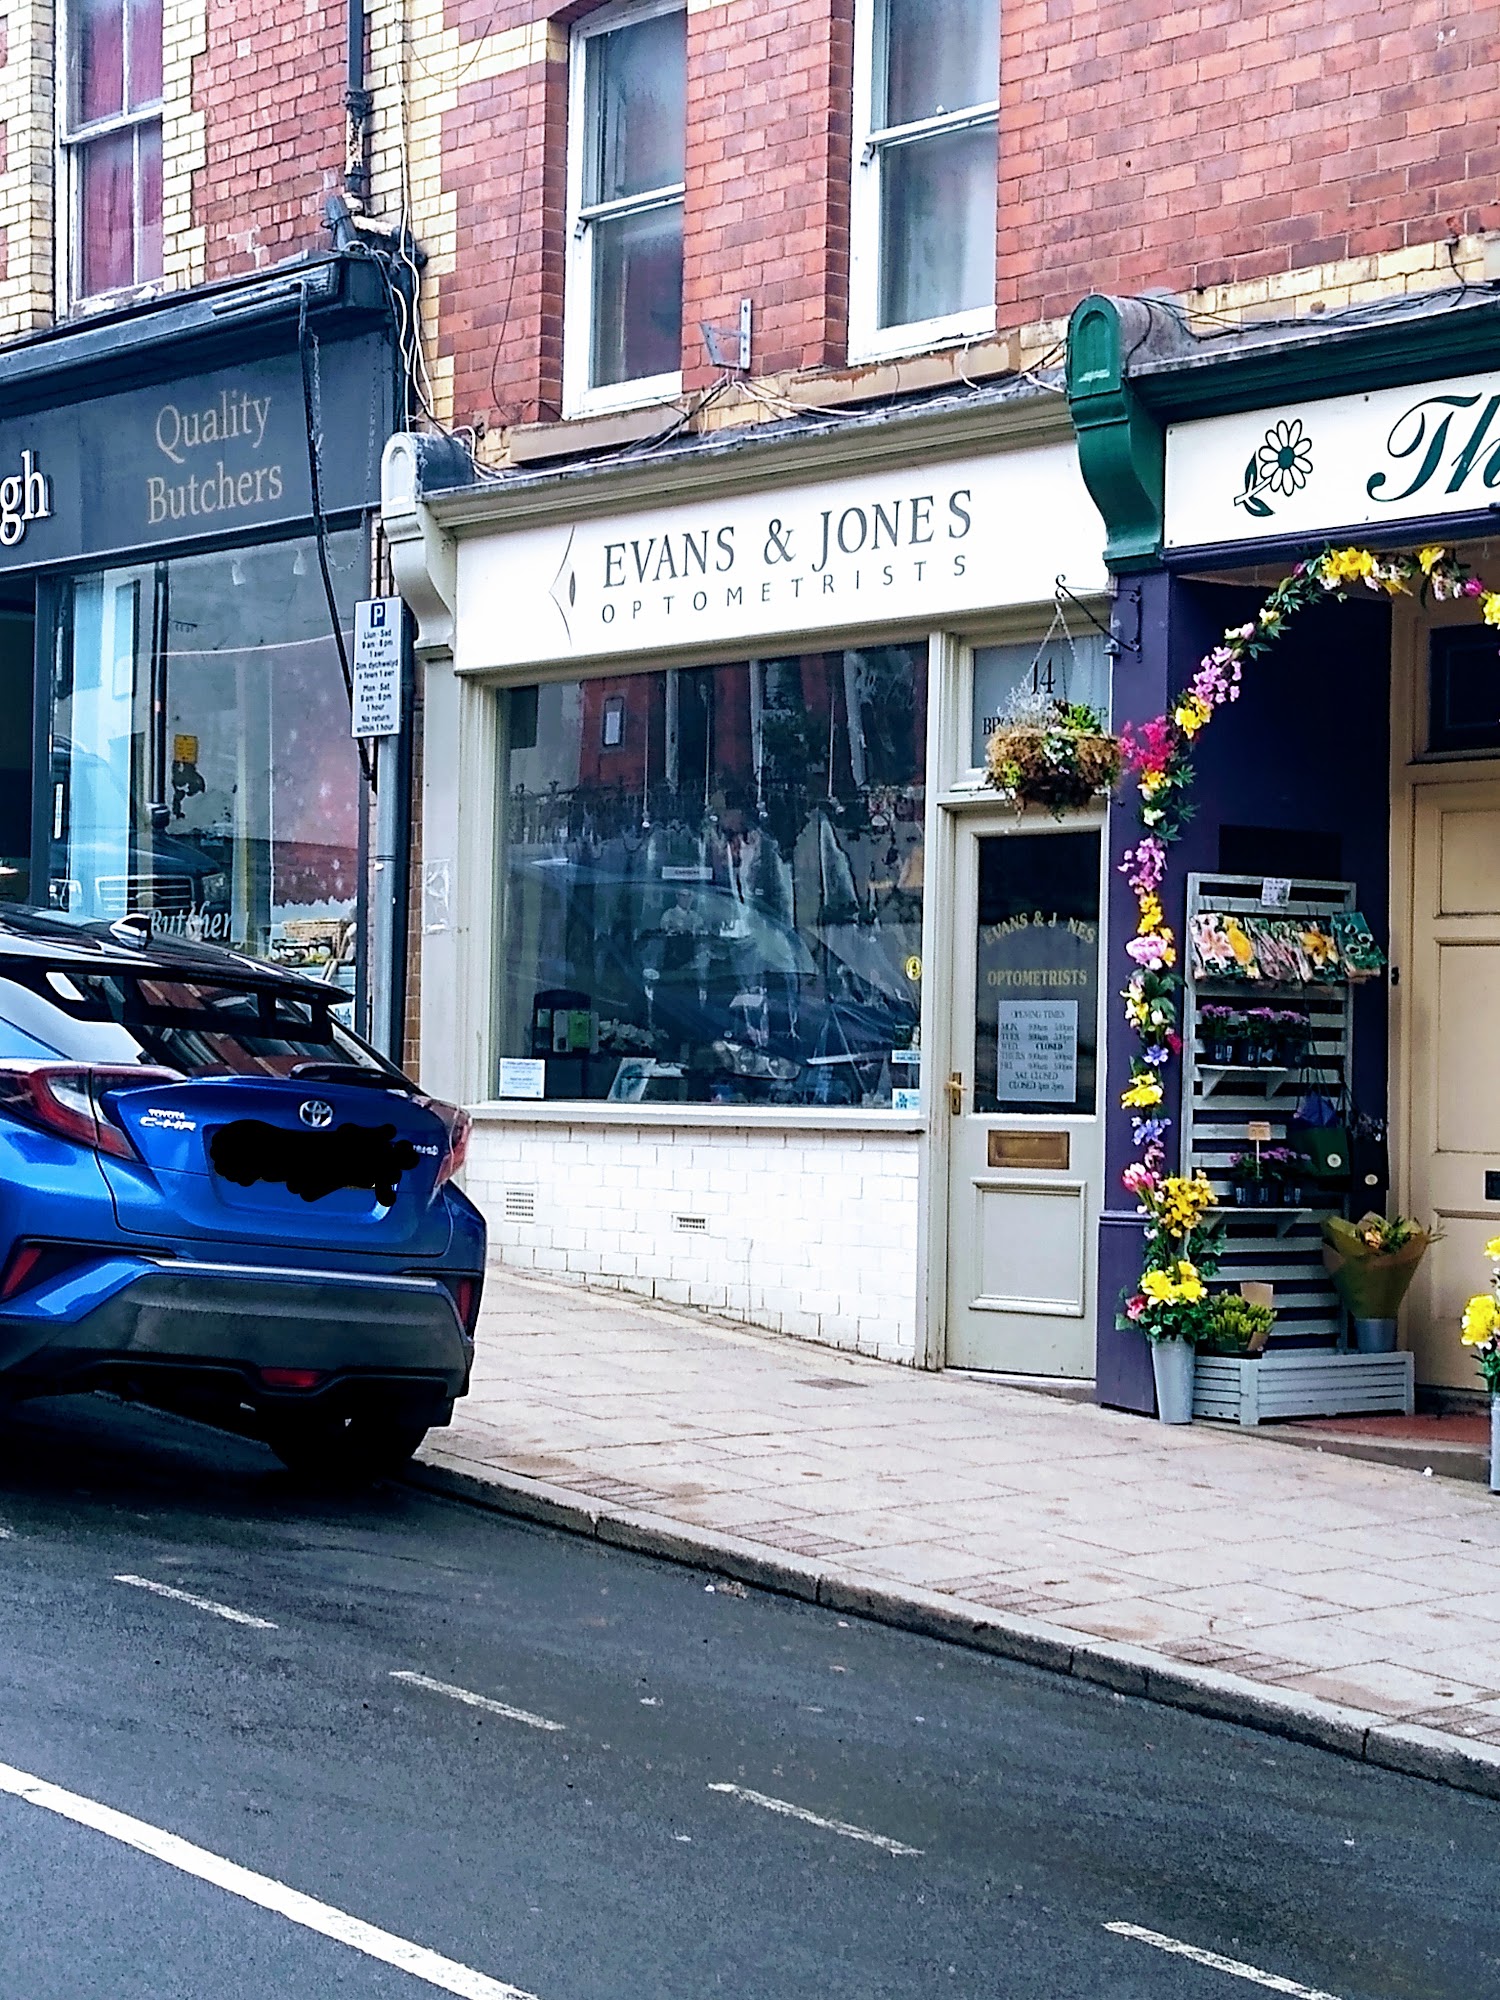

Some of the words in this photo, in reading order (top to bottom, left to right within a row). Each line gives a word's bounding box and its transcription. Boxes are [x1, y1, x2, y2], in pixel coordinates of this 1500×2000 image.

[156, 389, 272, 464] Quality
[147, 461, 283, 524] Butchers
[603, 526, 735, 588] EVANS
[763, 518, 797, 565] &
[811, 489, 972, 572] JONES
[601, 554, 967, 624] OPTOMETRISTS
[373, 604, 384, 626] P
[380, 629, 392, 638] Sad
[1032, 657, 1056, 695] 14
[362, 685, 376, 693] Mon
[380, 683, 390, 691] Sat
[361, 715, 370, 723] No
[371, 714, 390, 722] return
[356, 724, 375, 733] within
[380, 723, 394, 731] hour
[983, 912, 1028, 947] EVANS
[1033, 910, 1045, 928] &
[1047, 911, 1097, 945] JNES
[987, 970, 1088, 987] OPTOMETRISTS
[1036, 1042, 1063, 1050] CLOSED
[1030, 1071, 1059, 1080] CLOSED
[1008, 1081, 1036, 1090] CLOSED
[148, 1108, 186, 1120] TOYOTA
